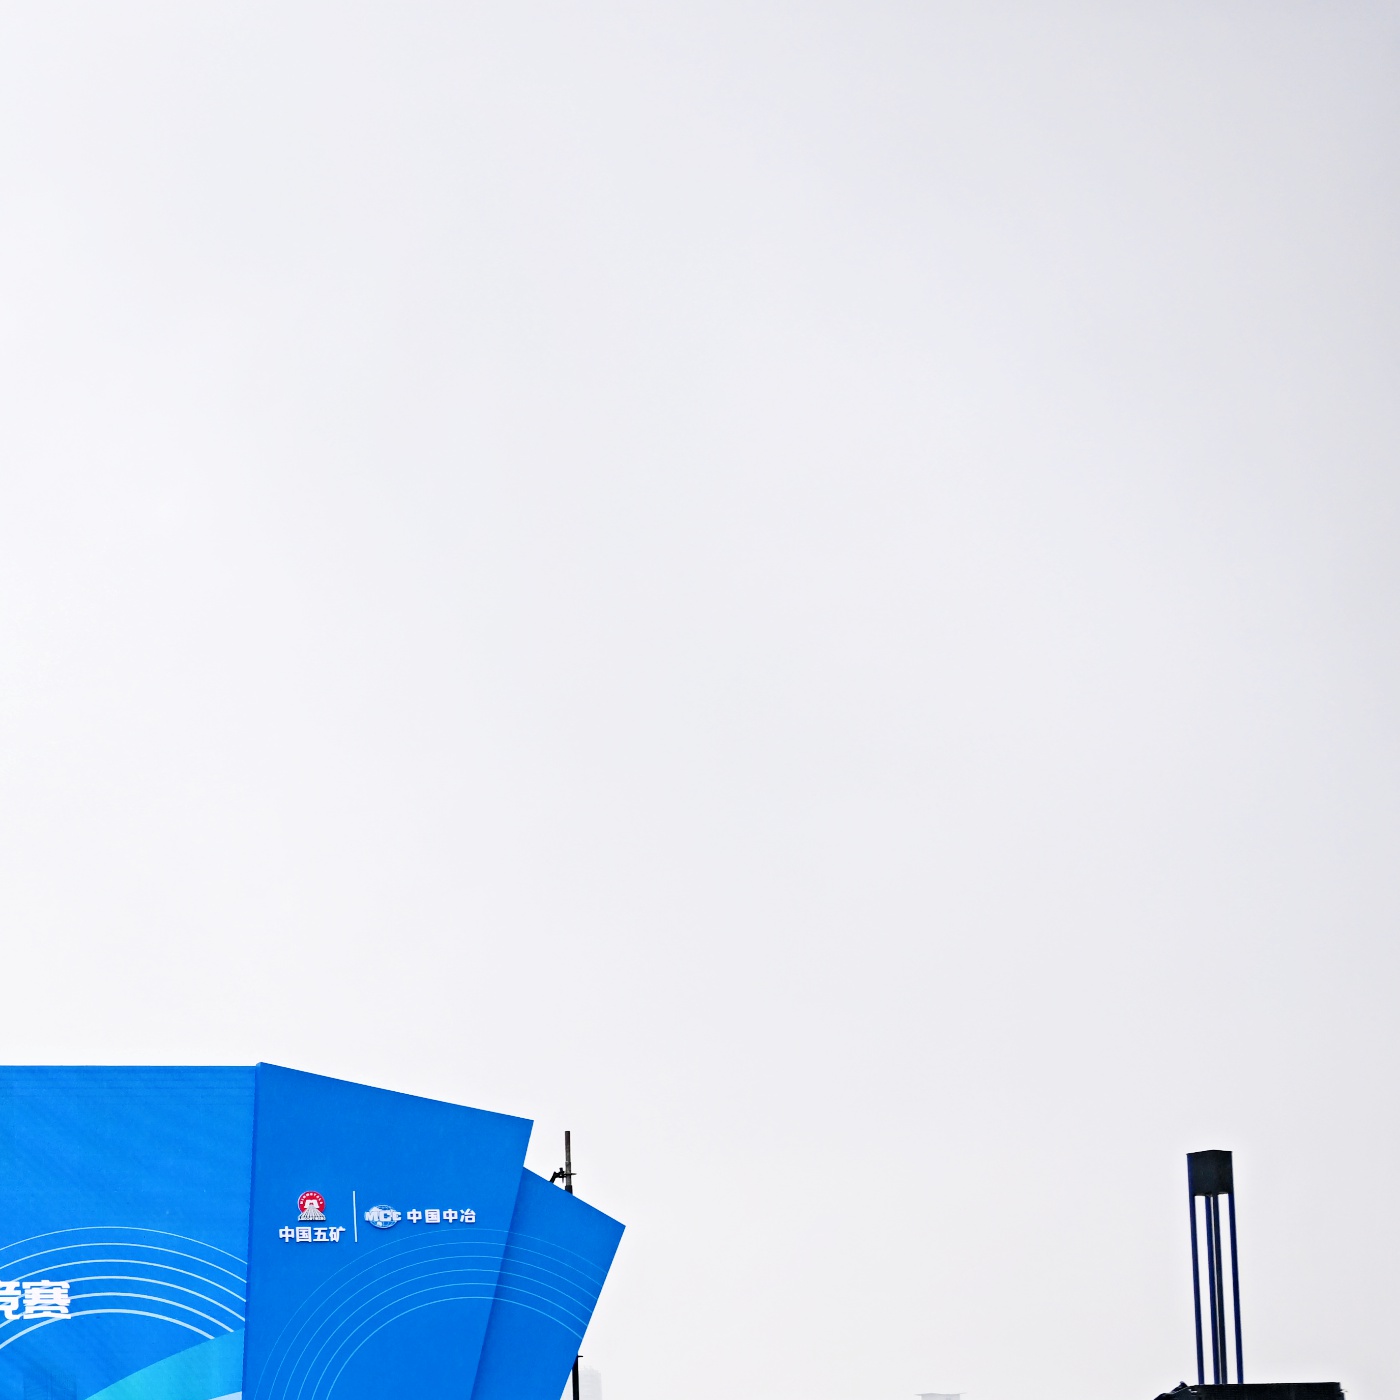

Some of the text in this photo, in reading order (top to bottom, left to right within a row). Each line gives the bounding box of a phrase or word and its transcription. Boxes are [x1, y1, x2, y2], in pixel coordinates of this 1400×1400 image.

[407, 1209, 476, 1223] 中国中冶
[279, 1226, 346, 1243] 中国五矿
